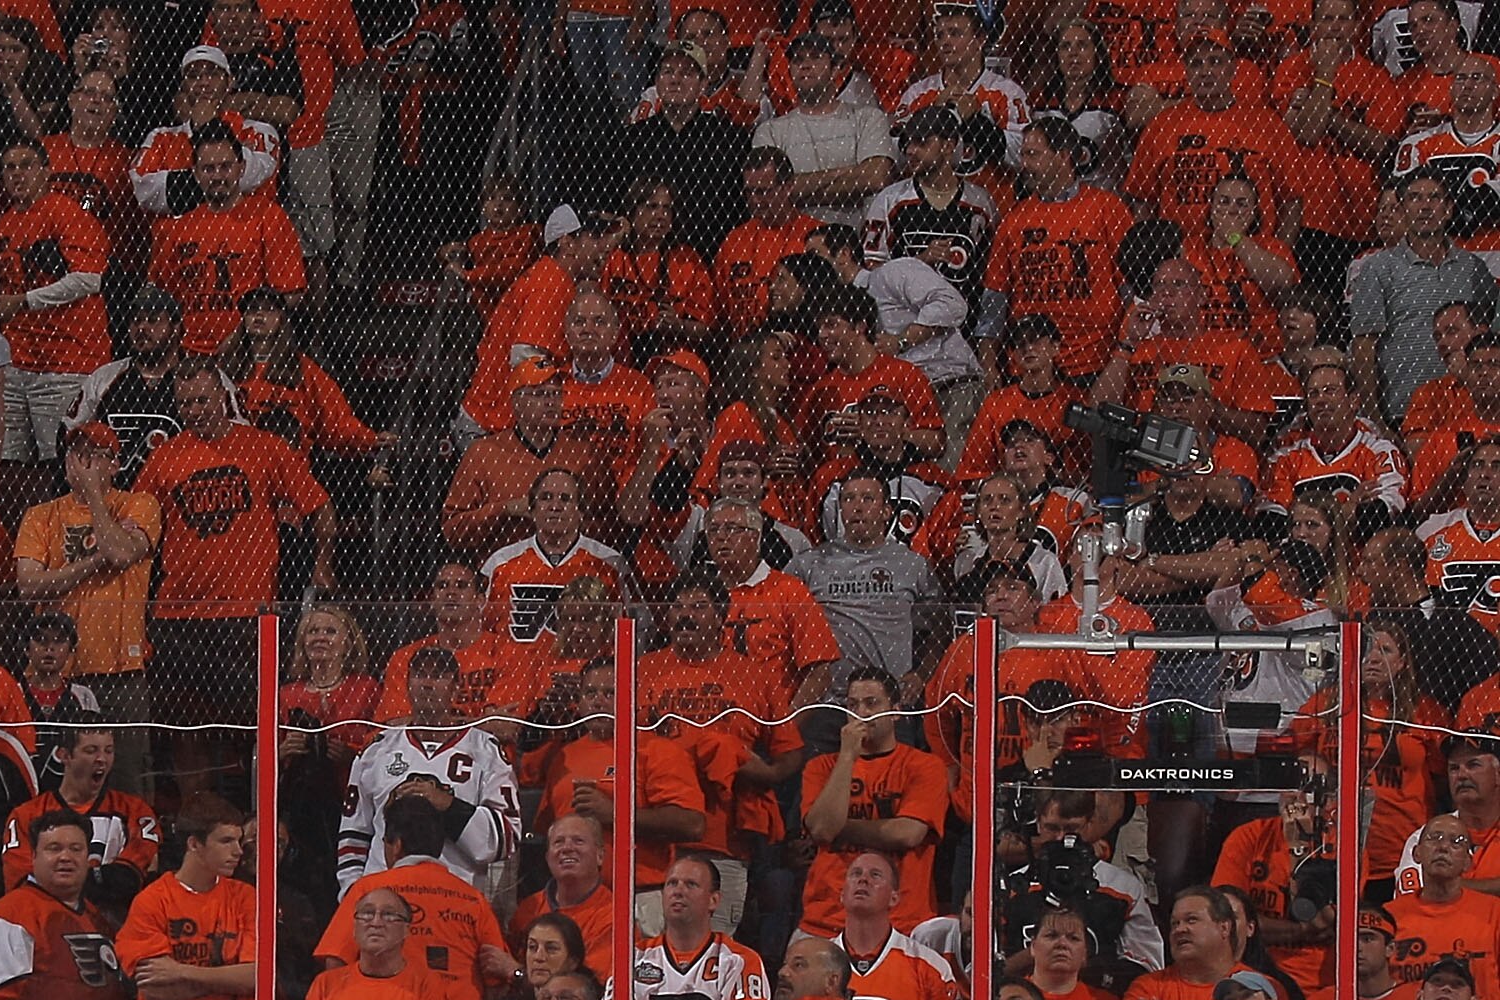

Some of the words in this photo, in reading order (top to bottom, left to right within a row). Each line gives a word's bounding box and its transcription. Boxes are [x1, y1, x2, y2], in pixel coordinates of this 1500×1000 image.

[561, 403, 630, 420] OGETHER
[828, 582, 894, 595] DOCTOR
[447, 752, 474, 784] C
[1120, 768, 1234, 780] DAKTRONICS
[138, 816, 160, 843] 2
[1400, 866, 1421, 893] 8
[734, 973, 763, 1000] 18
